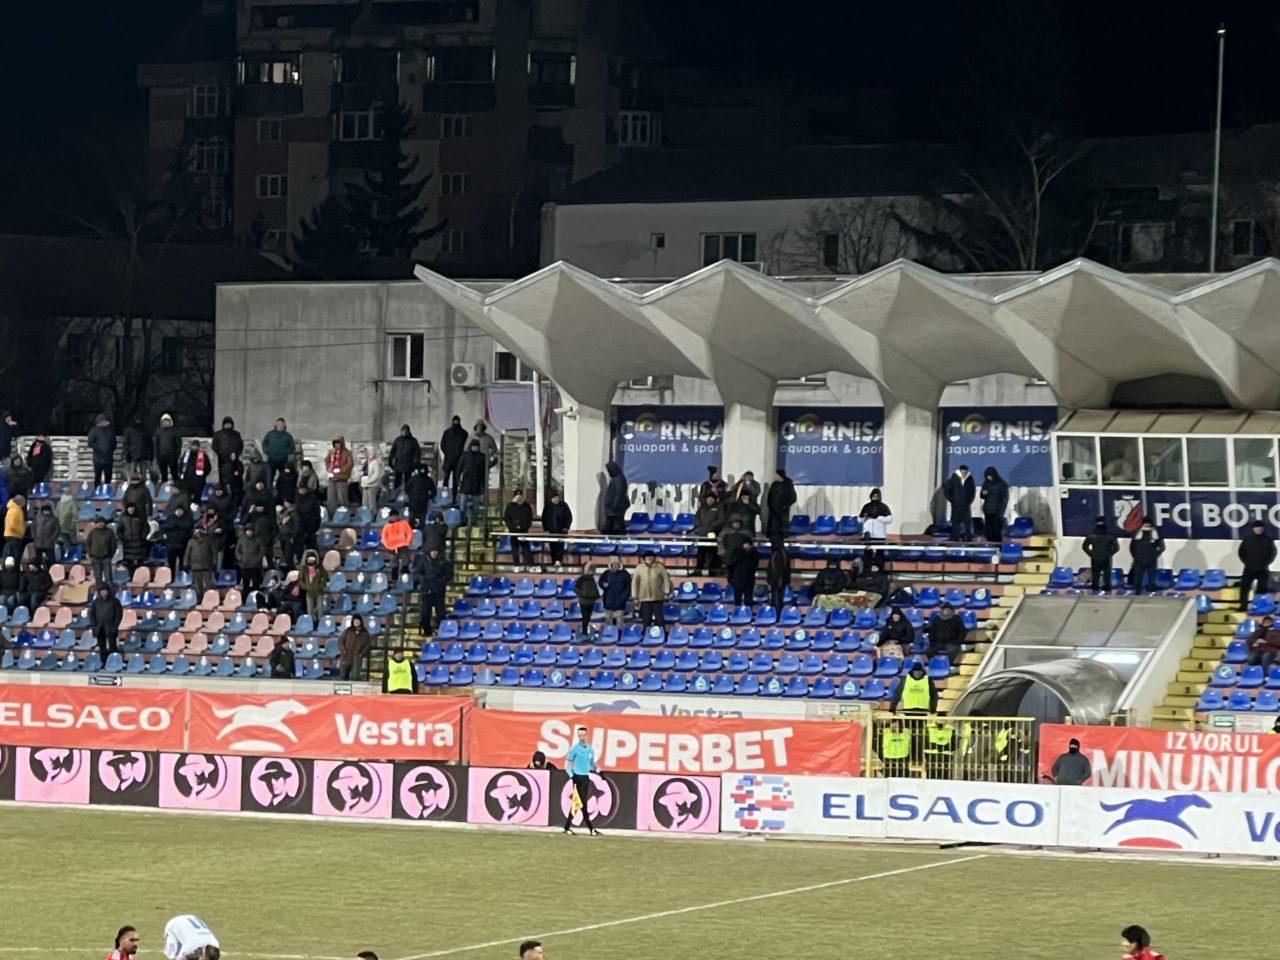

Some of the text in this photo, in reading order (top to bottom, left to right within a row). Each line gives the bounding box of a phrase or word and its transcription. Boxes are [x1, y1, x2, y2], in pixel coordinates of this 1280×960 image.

[620, 443, 676, 453] aquapark
[682, 443, 689, 452] &
[780, 444, 838, 454] aquapark
[843, 444, 851, 453] &
[946, 444, 1007, 455] aquapark
[1012, 444, 1020, 453] &
[1154, 503, 1191, 527] FC
[334, 713, 454, 746] Vestra
[1166, 731, 1263, 753] IZVORUL
[822, 793, 1044, 827] ELSACO
